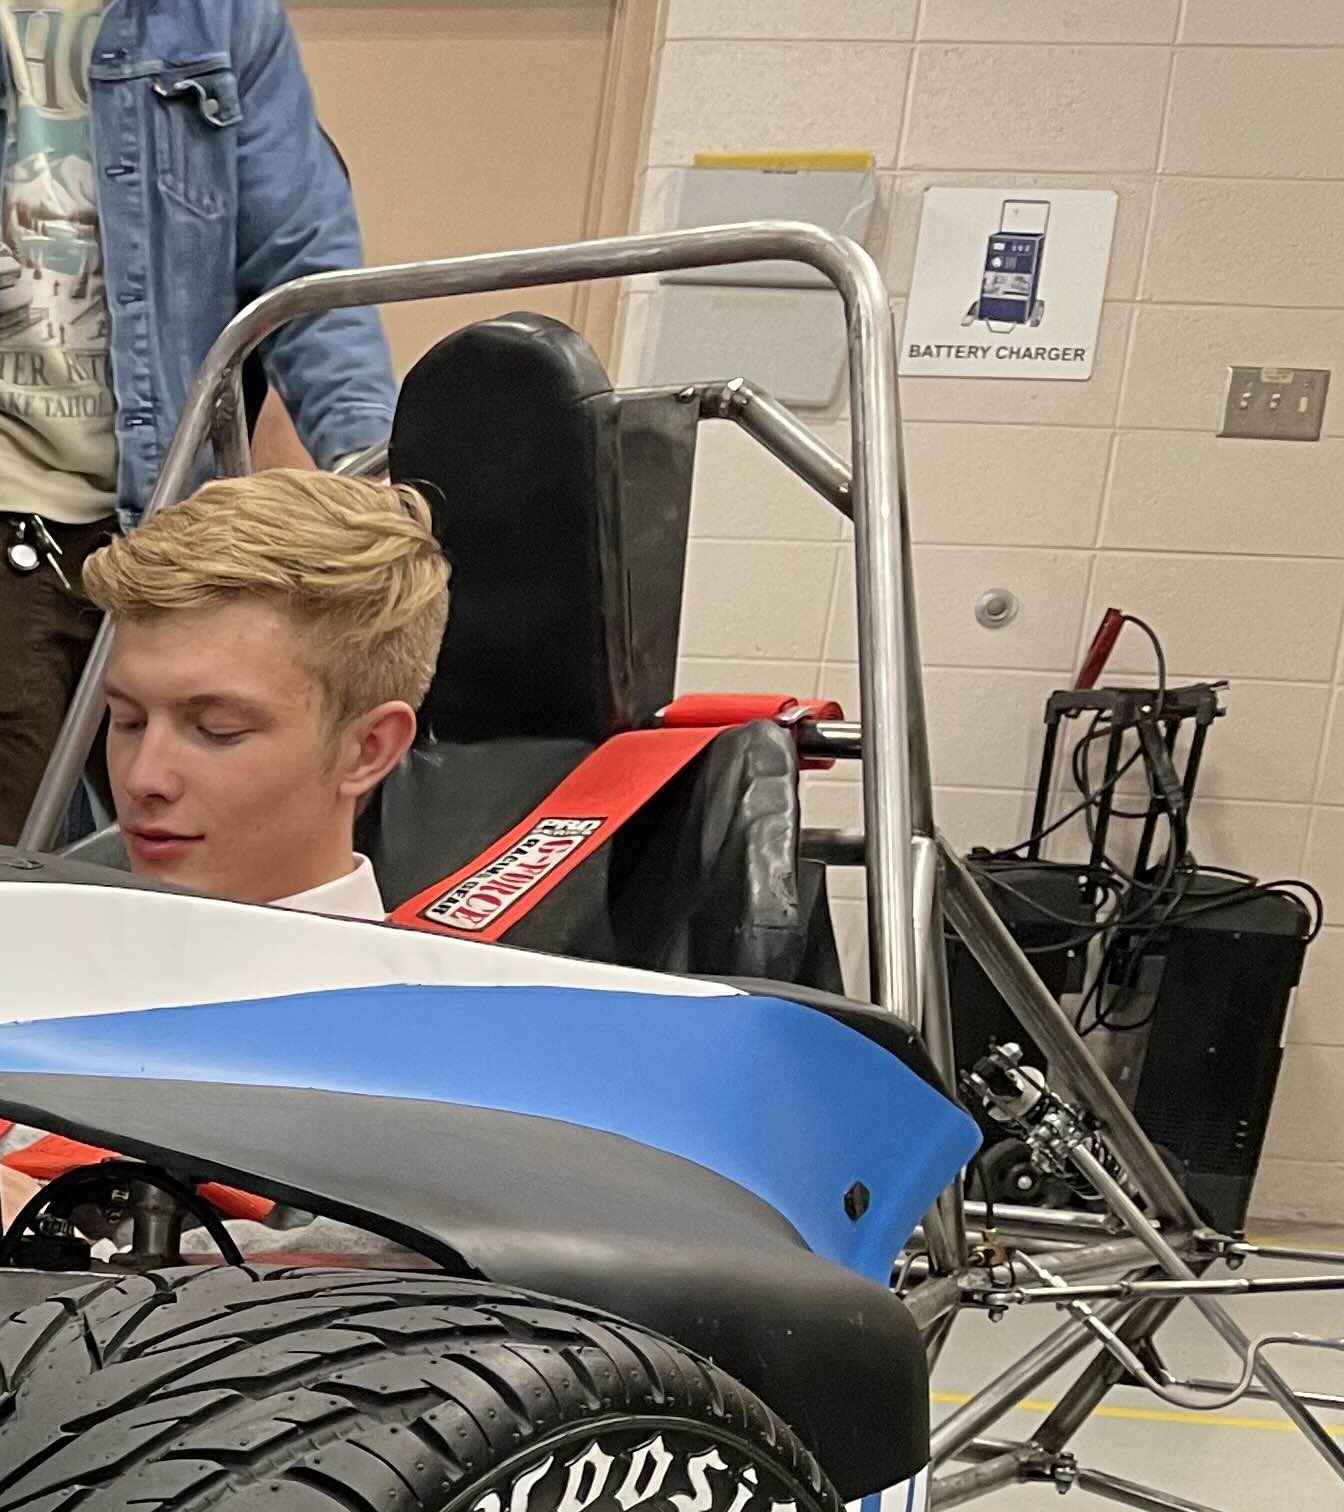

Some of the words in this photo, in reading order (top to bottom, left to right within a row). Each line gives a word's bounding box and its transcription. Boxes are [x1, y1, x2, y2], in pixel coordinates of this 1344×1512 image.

[909, 344, 991, 359] BATTERY
[996, 345, 1086, 362] CHARGER
[431, 881, 479, 915] GEAR
[450, 839, 575, 926] G-FORCE
